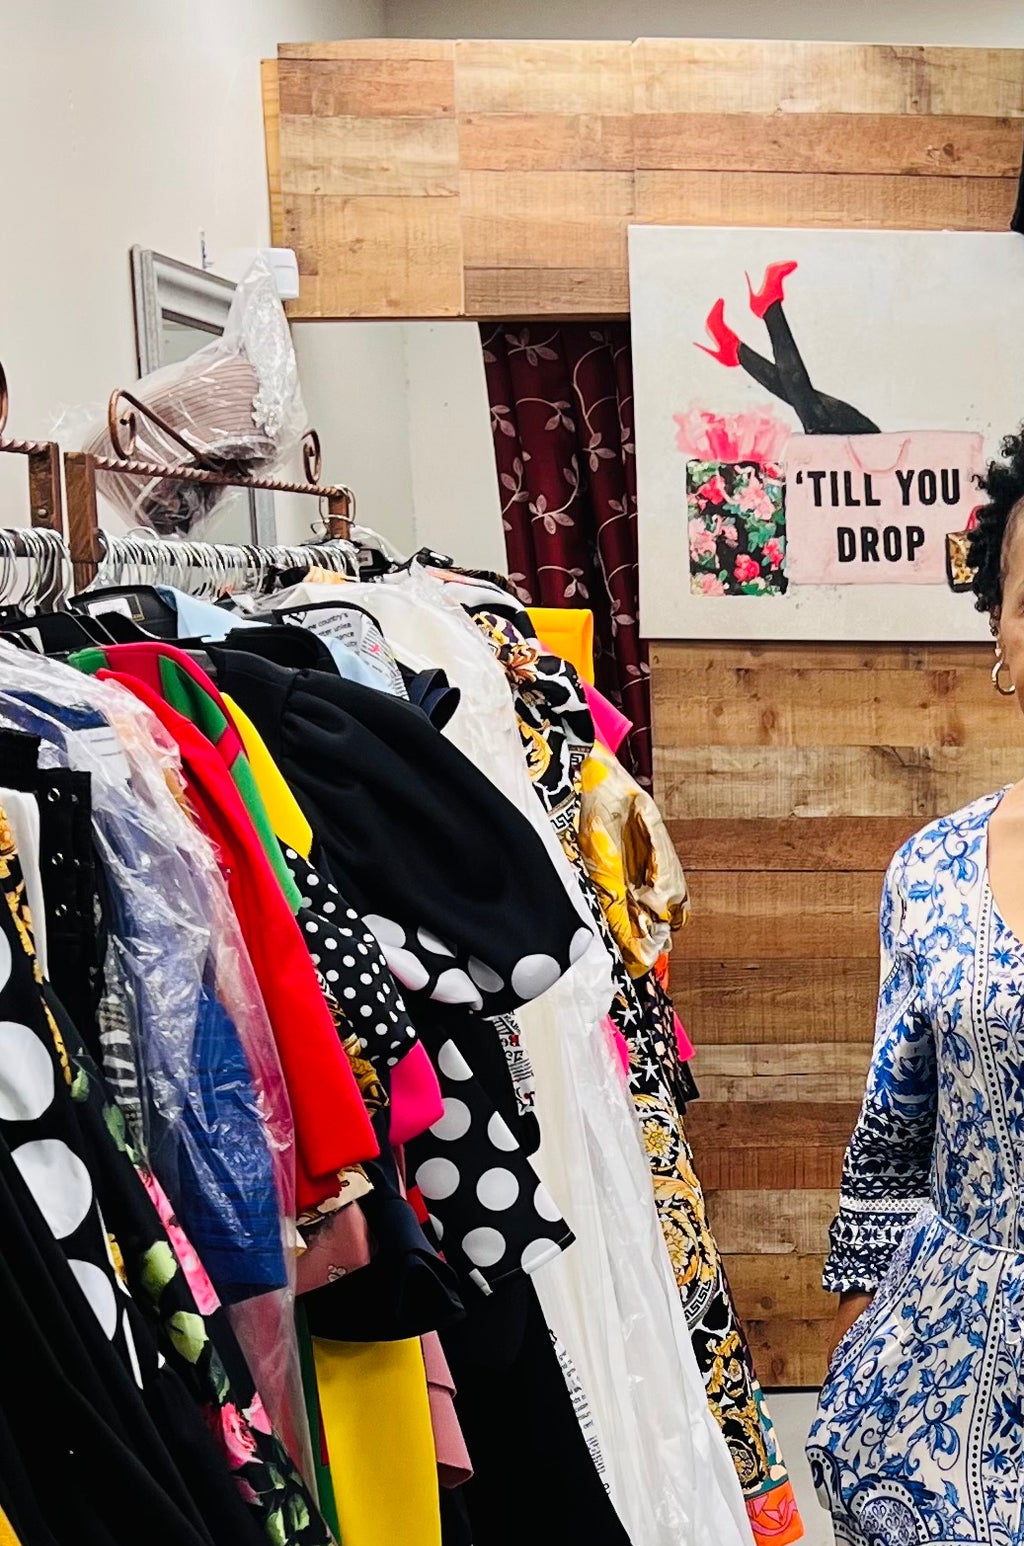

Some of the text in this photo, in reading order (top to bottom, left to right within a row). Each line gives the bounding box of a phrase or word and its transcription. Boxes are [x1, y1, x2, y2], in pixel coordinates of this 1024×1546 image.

[795, 468, 961, 507] 'TILL YOU
[836, 525, 925, 563] DROP
